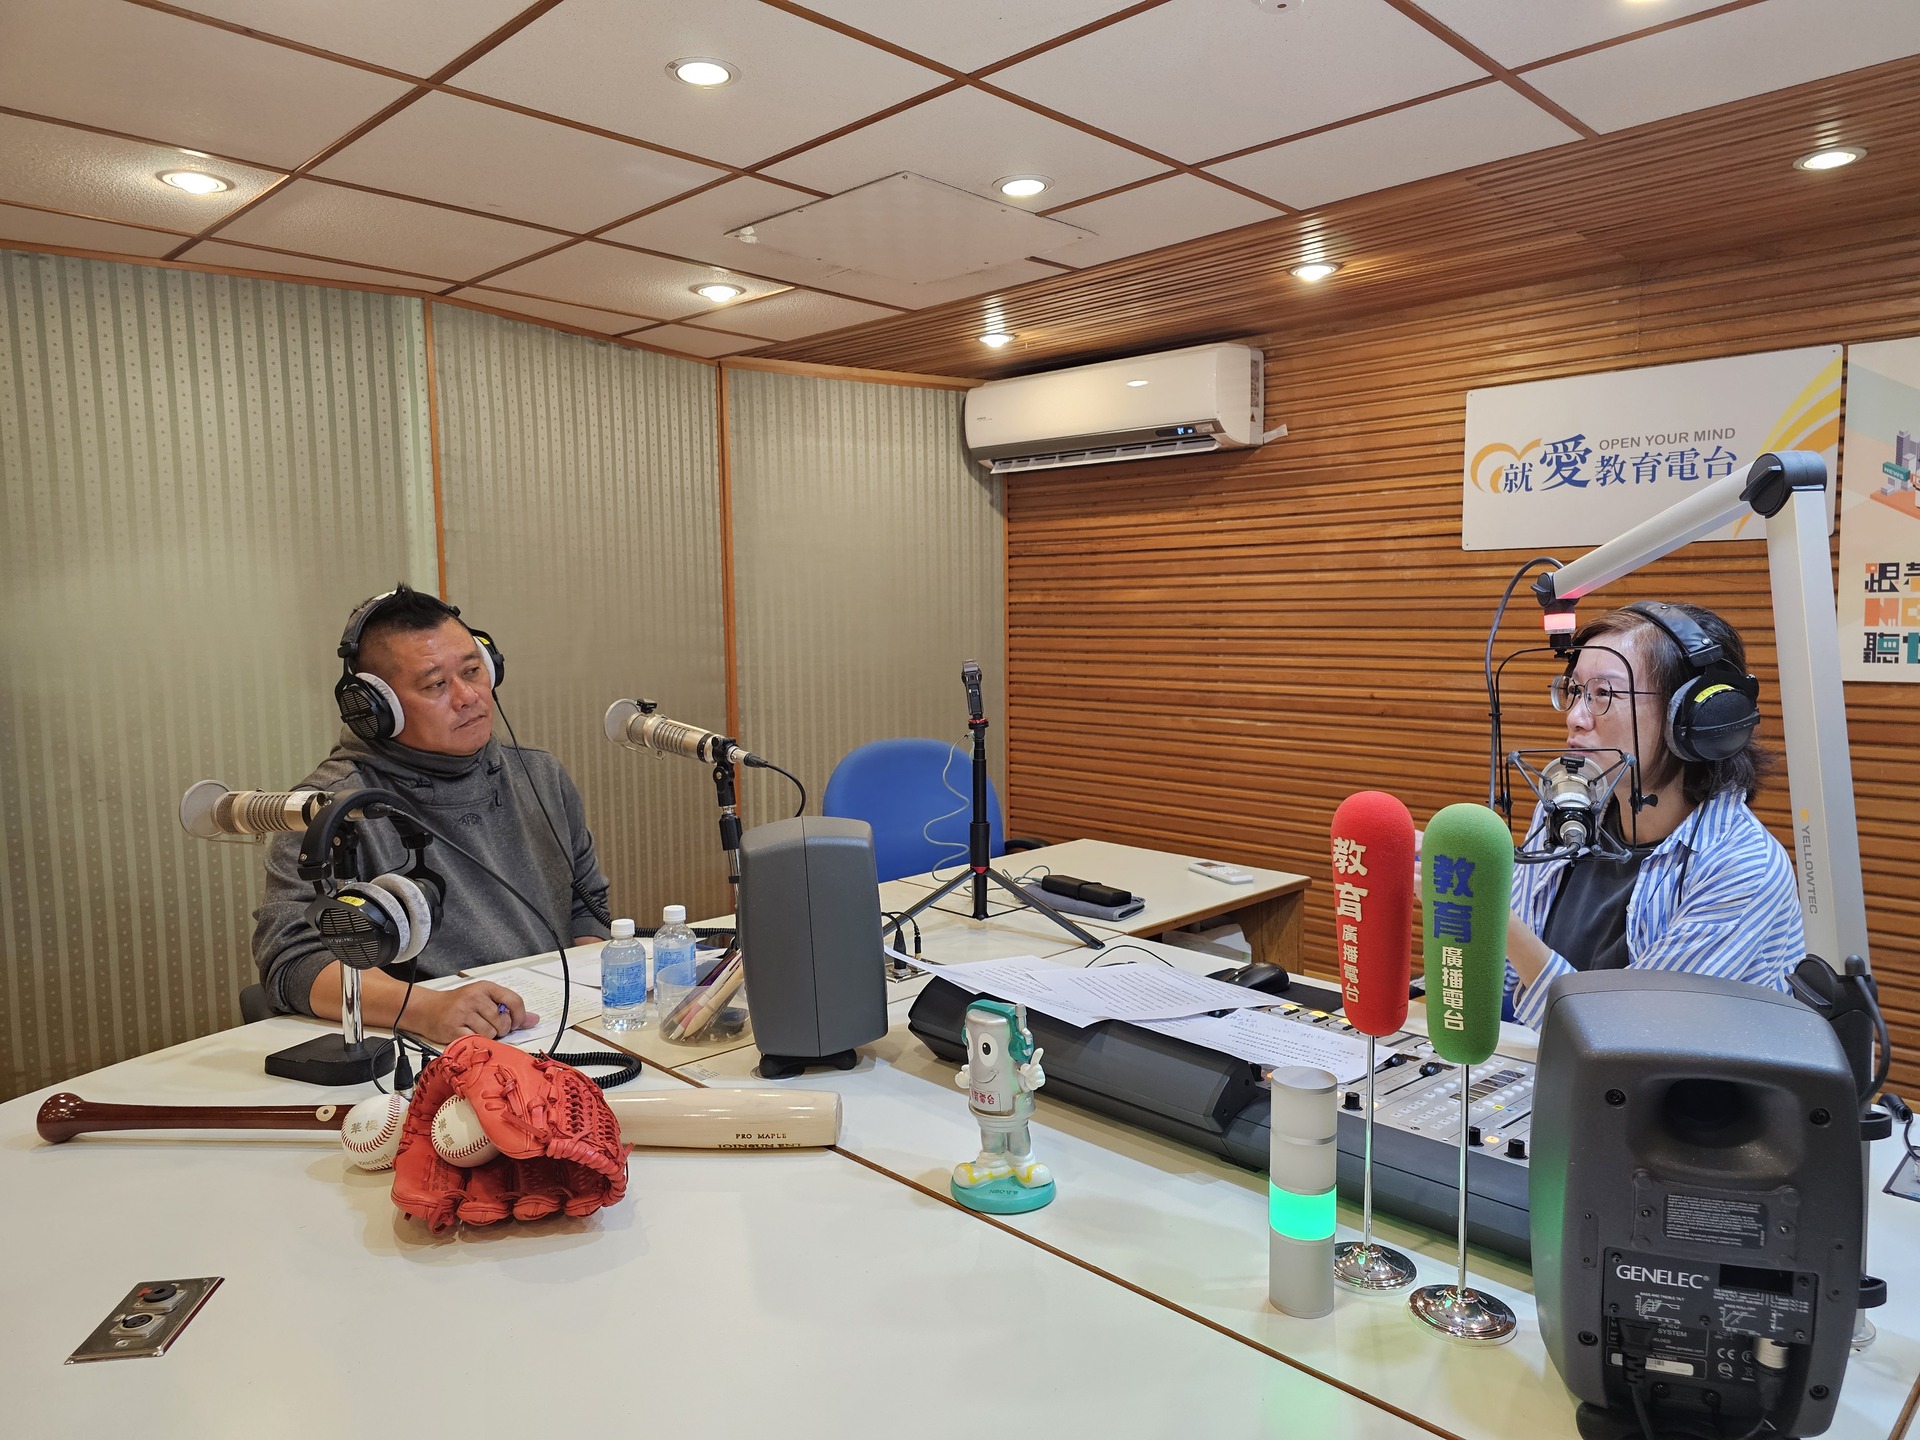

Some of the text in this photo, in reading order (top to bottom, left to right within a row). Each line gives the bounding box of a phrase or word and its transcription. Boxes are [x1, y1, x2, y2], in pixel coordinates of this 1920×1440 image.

[1599, 427, 1736, 451] OPEN YOUR MIND
[1884, 466, 1904, 480] NEWS
[1801, 825, 1818, 915] YELLOWTEC
[1615, 1264, 1704, 1290] GENELEC
[1657, 1327, 1687, 1338] SYSTEM
